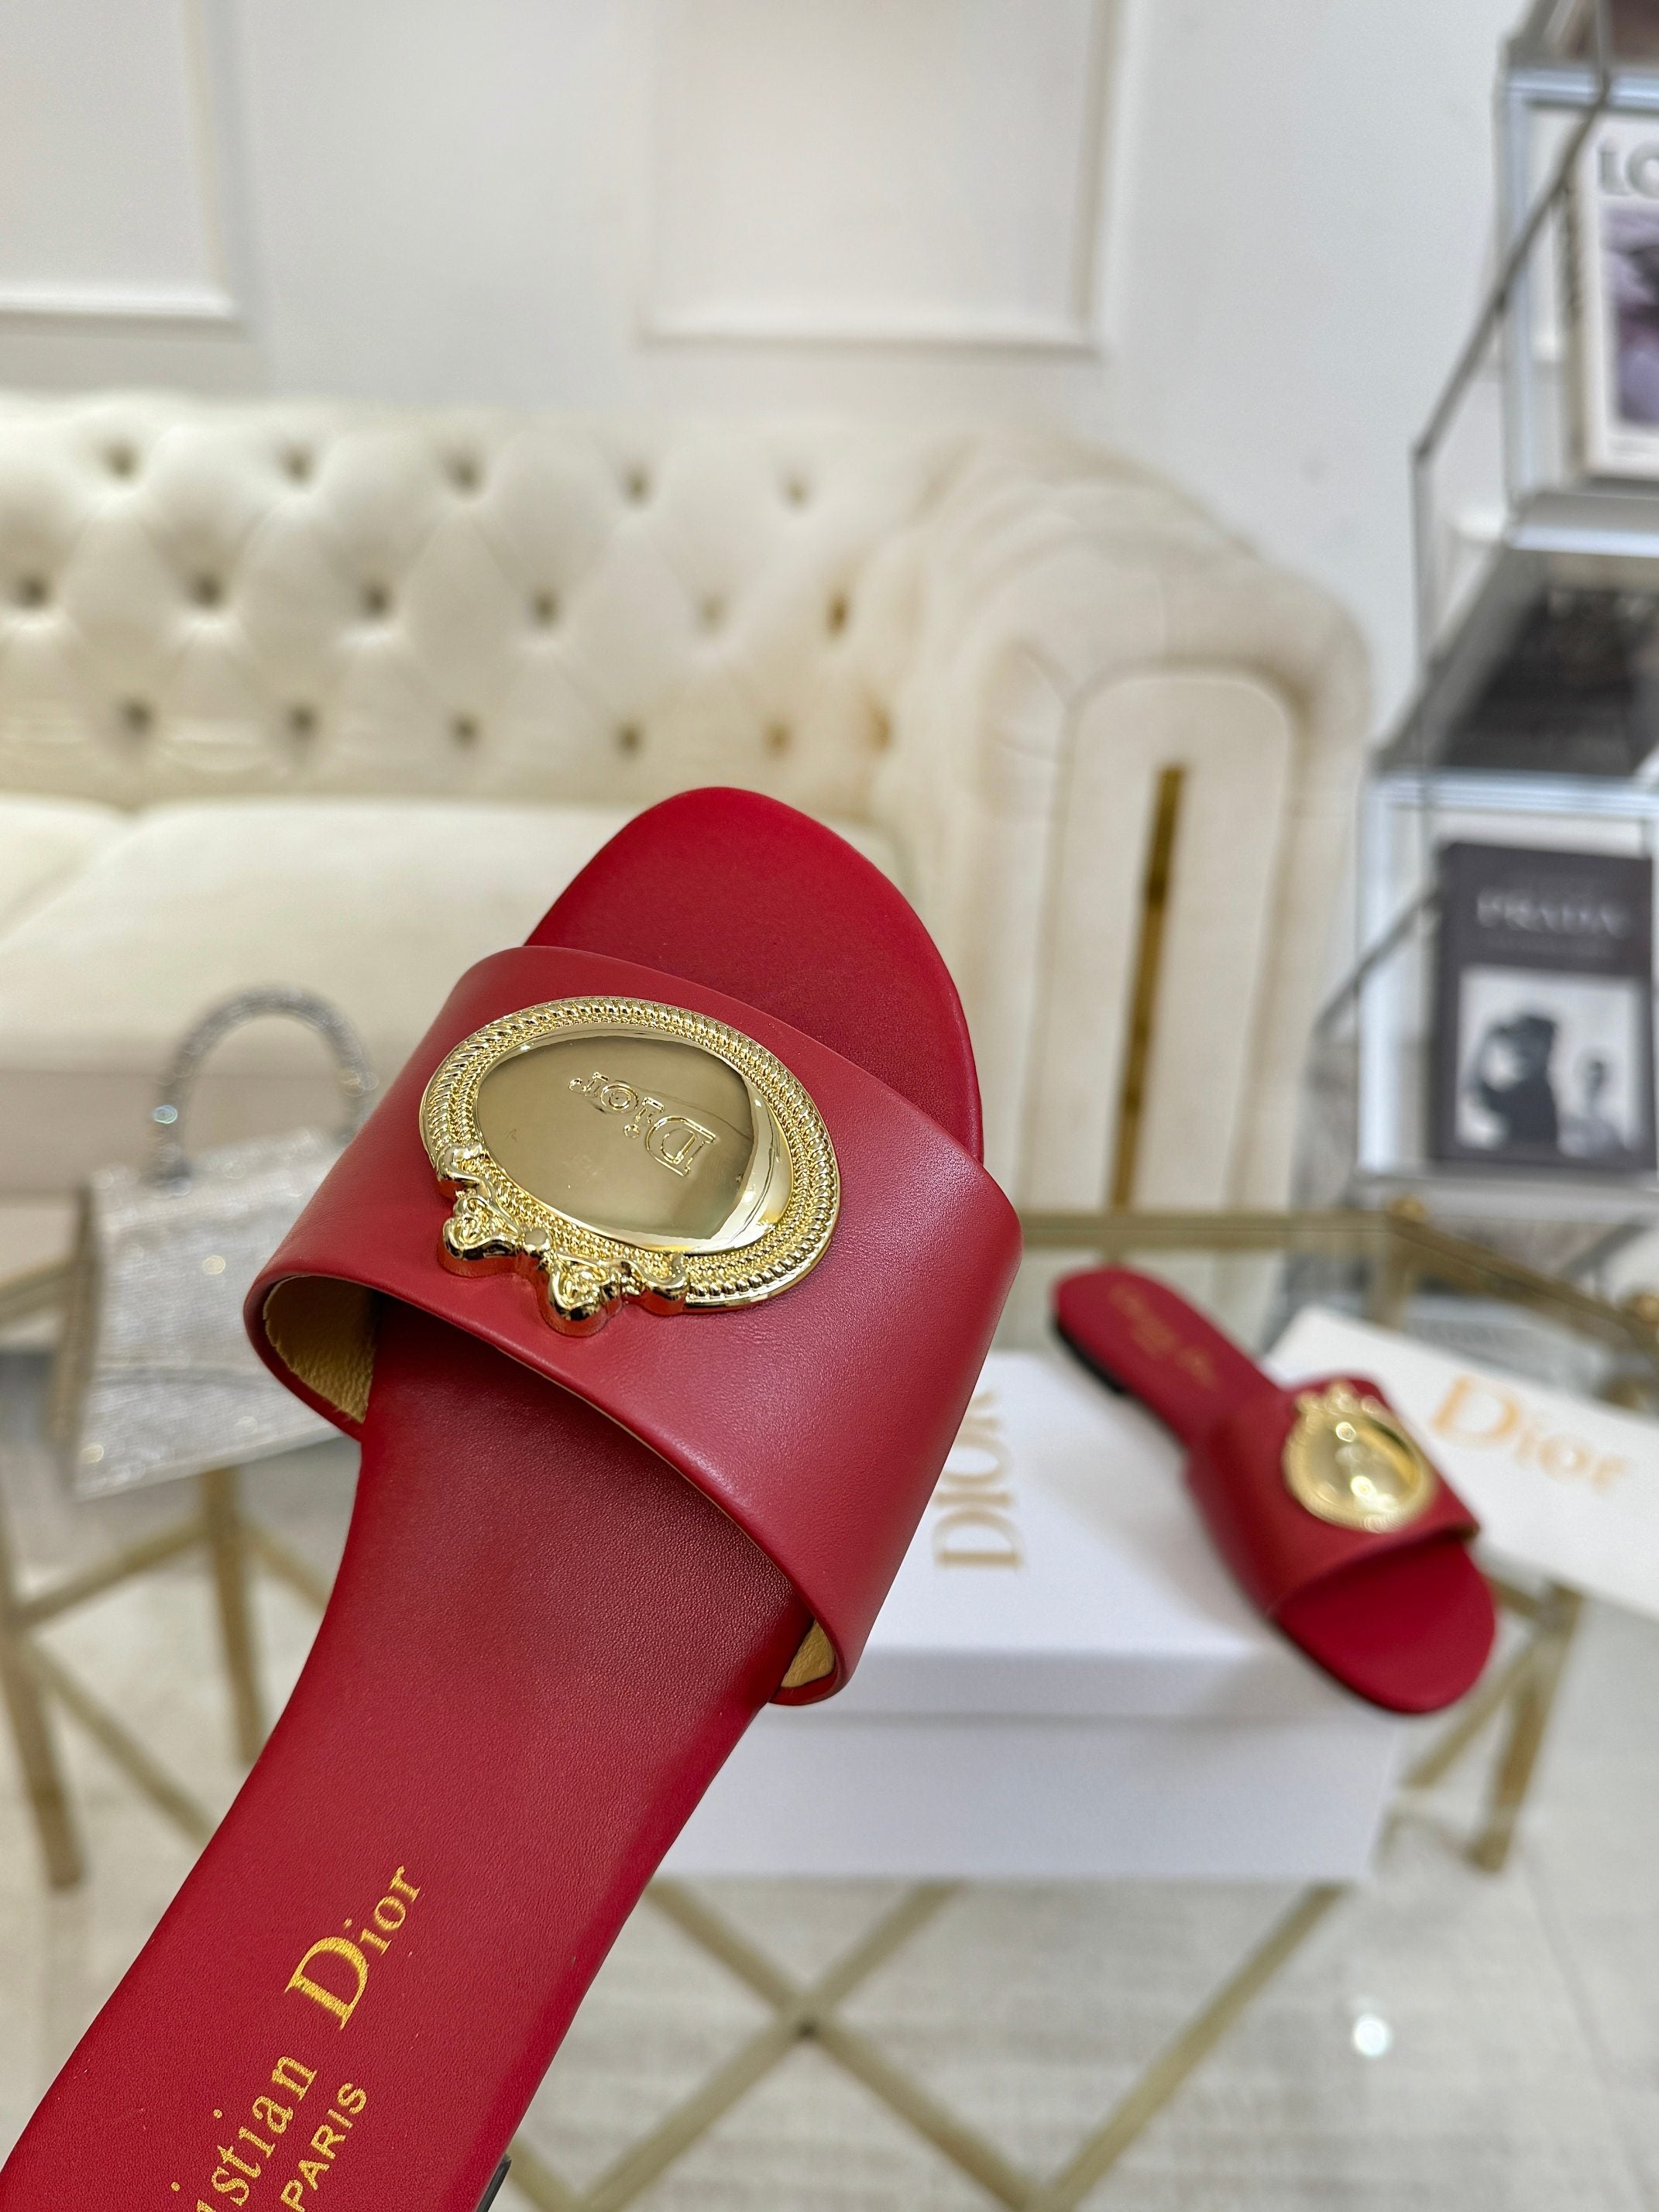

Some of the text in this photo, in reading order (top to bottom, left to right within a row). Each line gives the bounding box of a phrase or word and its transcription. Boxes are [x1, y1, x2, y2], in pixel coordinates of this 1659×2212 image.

[568, 1072, 717, 1177] Dior
[1431, 1376, 1629, 1493] Dior
[284, 1866, 421, 2030] Dior
[280, 2083, 367, 2212] PARIS
